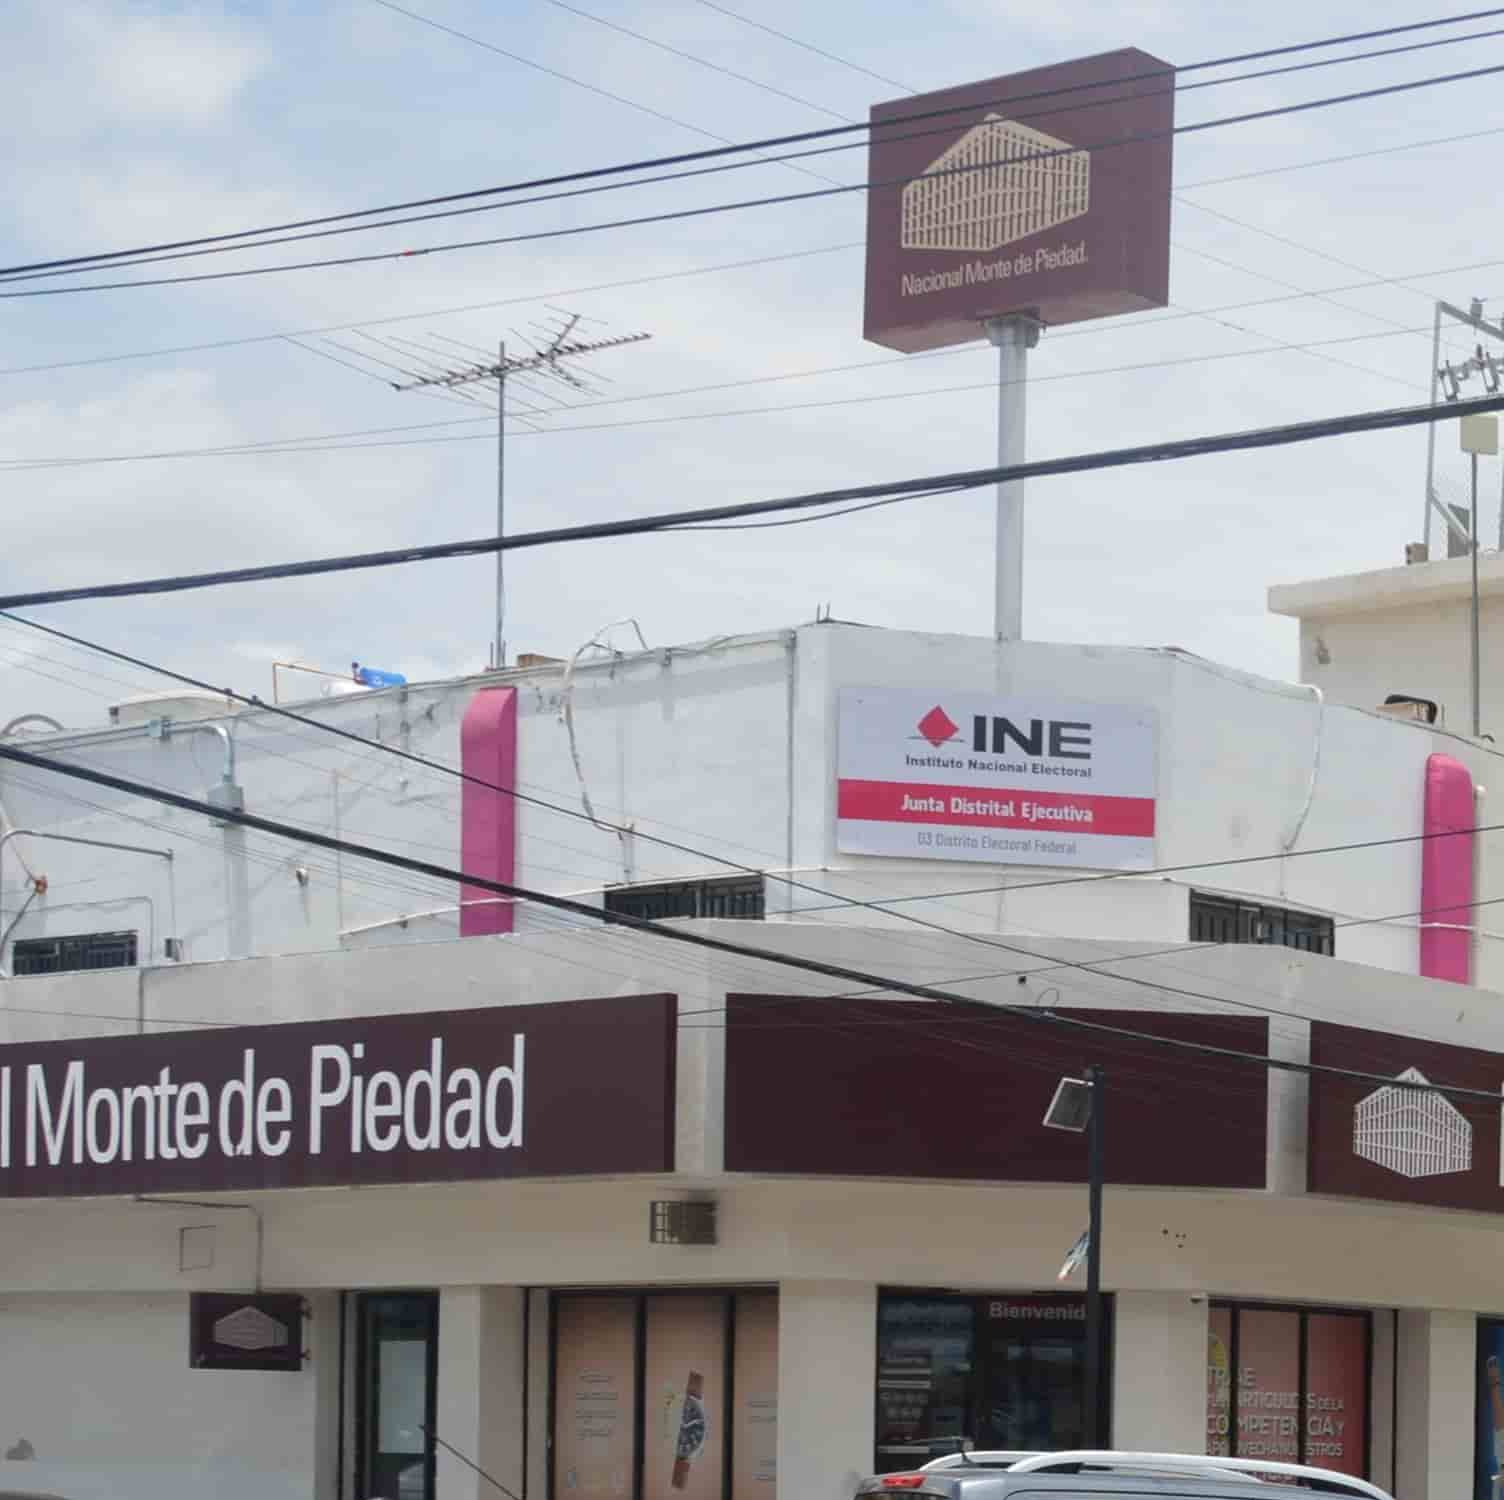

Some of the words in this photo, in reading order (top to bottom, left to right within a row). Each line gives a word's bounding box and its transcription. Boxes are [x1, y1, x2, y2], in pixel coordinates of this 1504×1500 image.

[902, 264, 963, 297] Nacional
[965, 259, 1012, 285] Monte
[1014, 253, 1033, 275] de
[972, 715, 1092, 760] INE
[905, 754, 963, 769] Instituto
[967, 760, 1028, 774] Nacional
[1031, 763, 1092, 777] Electoral
[901, 794, 945, 813] Junta
[951, 798, 1015, 817] Distrital
[1021, 801, 1094, 823] Ejecutiva
[935, 832, 979, 849] Distrito
[981, 835, 1032, 851] Electoral
[1034, 839, 1077, 854] Federal
[26, 1060, 211, 1168] Monte
[218, 1048, 292, 1158] de
[309, 1033, 526, 1155] Piedad
[988, 1301, 1087, 1321] Bienvenid
